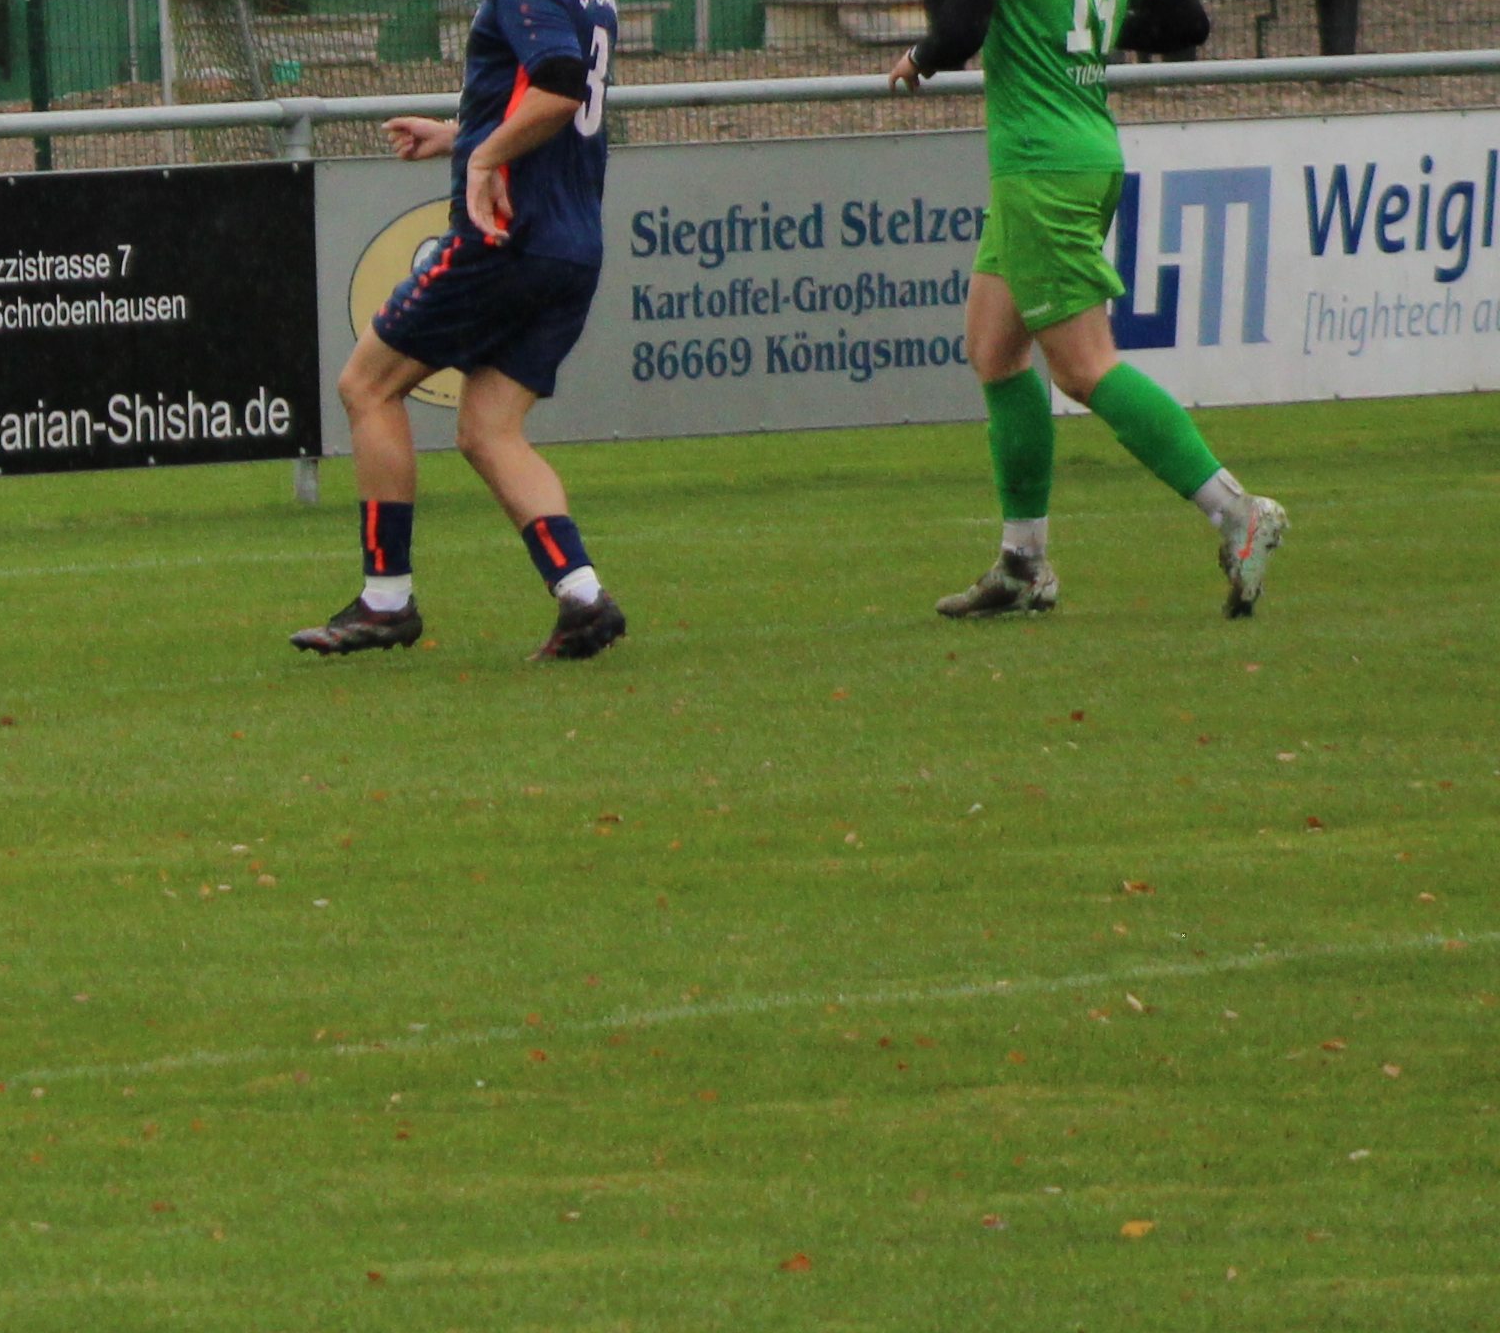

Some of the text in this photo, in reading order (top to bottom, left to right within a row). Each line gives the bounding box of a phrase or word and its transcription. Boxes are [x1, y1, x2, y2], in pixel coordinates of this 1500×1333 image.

[630, 201, 825, 269] Siegfried
[1304, 148, 1498, 283] Weigl
[117, 244, 132, 276] 7
[632, 328, 970, 383] 86669 Königsmoo
